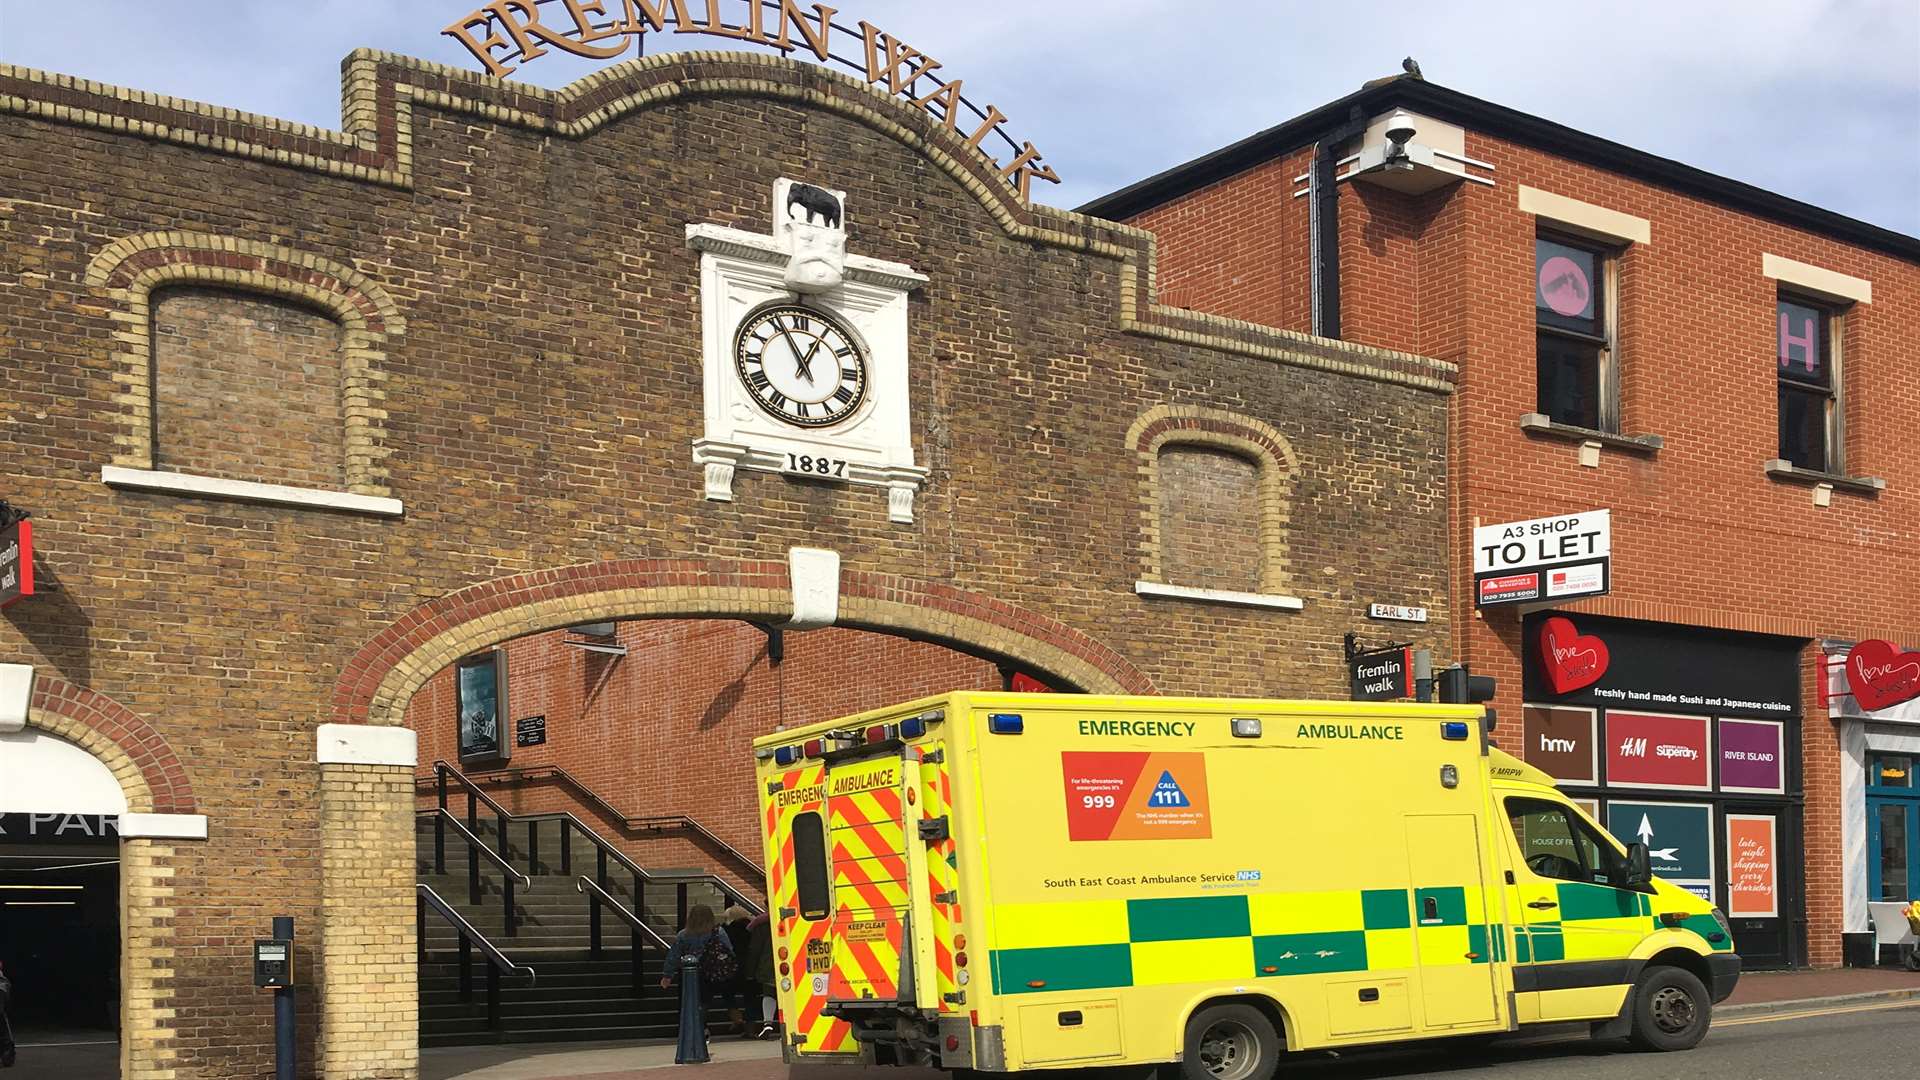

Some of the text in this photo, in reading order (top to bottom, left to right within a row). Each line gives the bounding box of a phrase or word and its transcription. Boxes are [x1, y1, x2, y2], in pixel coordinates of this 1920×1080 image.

[857, 19, 1061, 206] WALK
[1780, 312, 1814, 372] H
[787, 452, 847, 477] 1887
[1503, 518, 1579, 540] A3 SHOP
[1482, 531, 1601, 567] TO LET
[1375, 605, 1402, 617] EARL
[1357, 660, 1400, 679] fremlin
[1365, 677, 1394, 694] walk
[1594, 688, 1791, 711] freshly hand made Sushi and Japanese cuisine
[1078, 720, 1196, 737] EMERGENCY
[1297, 724, 1403, 740] AMBULANCE
[1541, 734, 1575, 753] hmv
[1620, 737, 1647, 758] H&M
[1725, 751, 1774, 762] RIVER ISLAND
[833, 769, 894, 794] AMBULANCE
[778, 785, 825, 807] EMERGENC
[1083, 795, 1115, 808] 999
[1154, 790, 1180, 804] 111
[29, 813, 119, 836] PAR
[1540, 815, 1567, 823] ZAR
[1532, 838, 1554, 846] HOUSE
[1739, 837, 1757, 847] late
[1742, 846, 1765, 860] night
[1734, 858, 1770, 872] shopping
[1044, 871, 1260, 888] South East Coast Ambulance Service NHS
[1740, 873, 1763, 883] every
[1734, 881, 1772, 895] thursday
[848, 921, 886, 931] KEEP CLEAR
